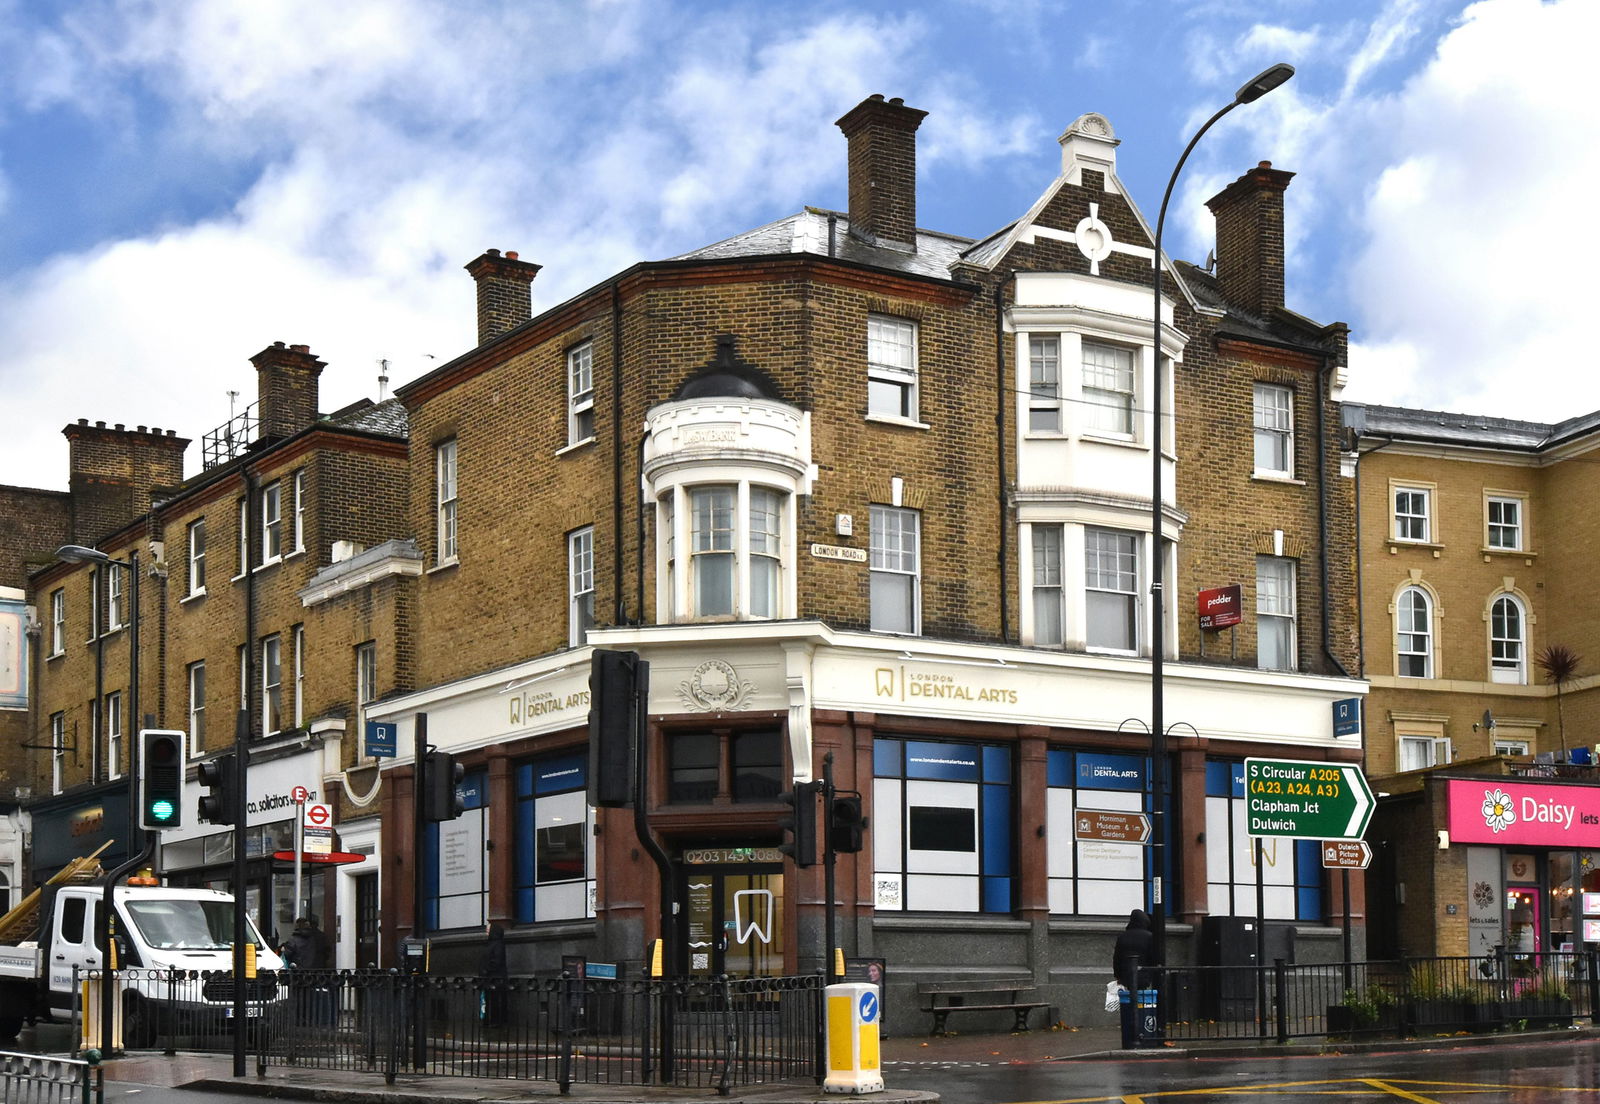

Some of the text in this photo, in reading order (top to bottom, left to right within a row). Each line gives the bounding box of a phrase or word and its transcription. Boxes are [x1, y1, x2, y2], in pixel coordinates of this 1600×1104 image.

[814, 546, 839, 557] LONDON
[841, 550, 857, 559] ROAD
[1207, 594, 1232, 609] pedder
[1200, 620, 1213, 628] SALE
[911, 673, 954, 683] LONDON
[528, 692, 553, 703] LONDON
[910, 682, 1018, 704] DENTAL ARTS
[528, 691, 590, 718] DENTAL ARTS
[910, 757, 976, 766] www.londondentalarts.co.uk
[1094, 769, 1138, 778] DENTAL ARTS
[1250, 765, 1340, 782] S Circular A205
[295, 788, 303, 801] E
[1316, 784, 1339, 798] A3)
[259, 791, 289, 812] solicitors
[1251, 798, 1319, 814] Clapham Jct
[1099, 815, 1127, 823] Horniman
[1521, 796, 1599, 830] Daisy lets
[1096, 822, 1120, 830] Museum
[1252, 817, 1296, 831] Dulwich
[1101, 830, 1125, 839] Gardens
[1338, 843, 1360, 851] Dulwich
[686, 851, 720, 863] 0203
[1340, 858, 1359, 866] Gallery
[1470, 916, 1481, 924] lets
[1485, 916, 1499, 924] sales
